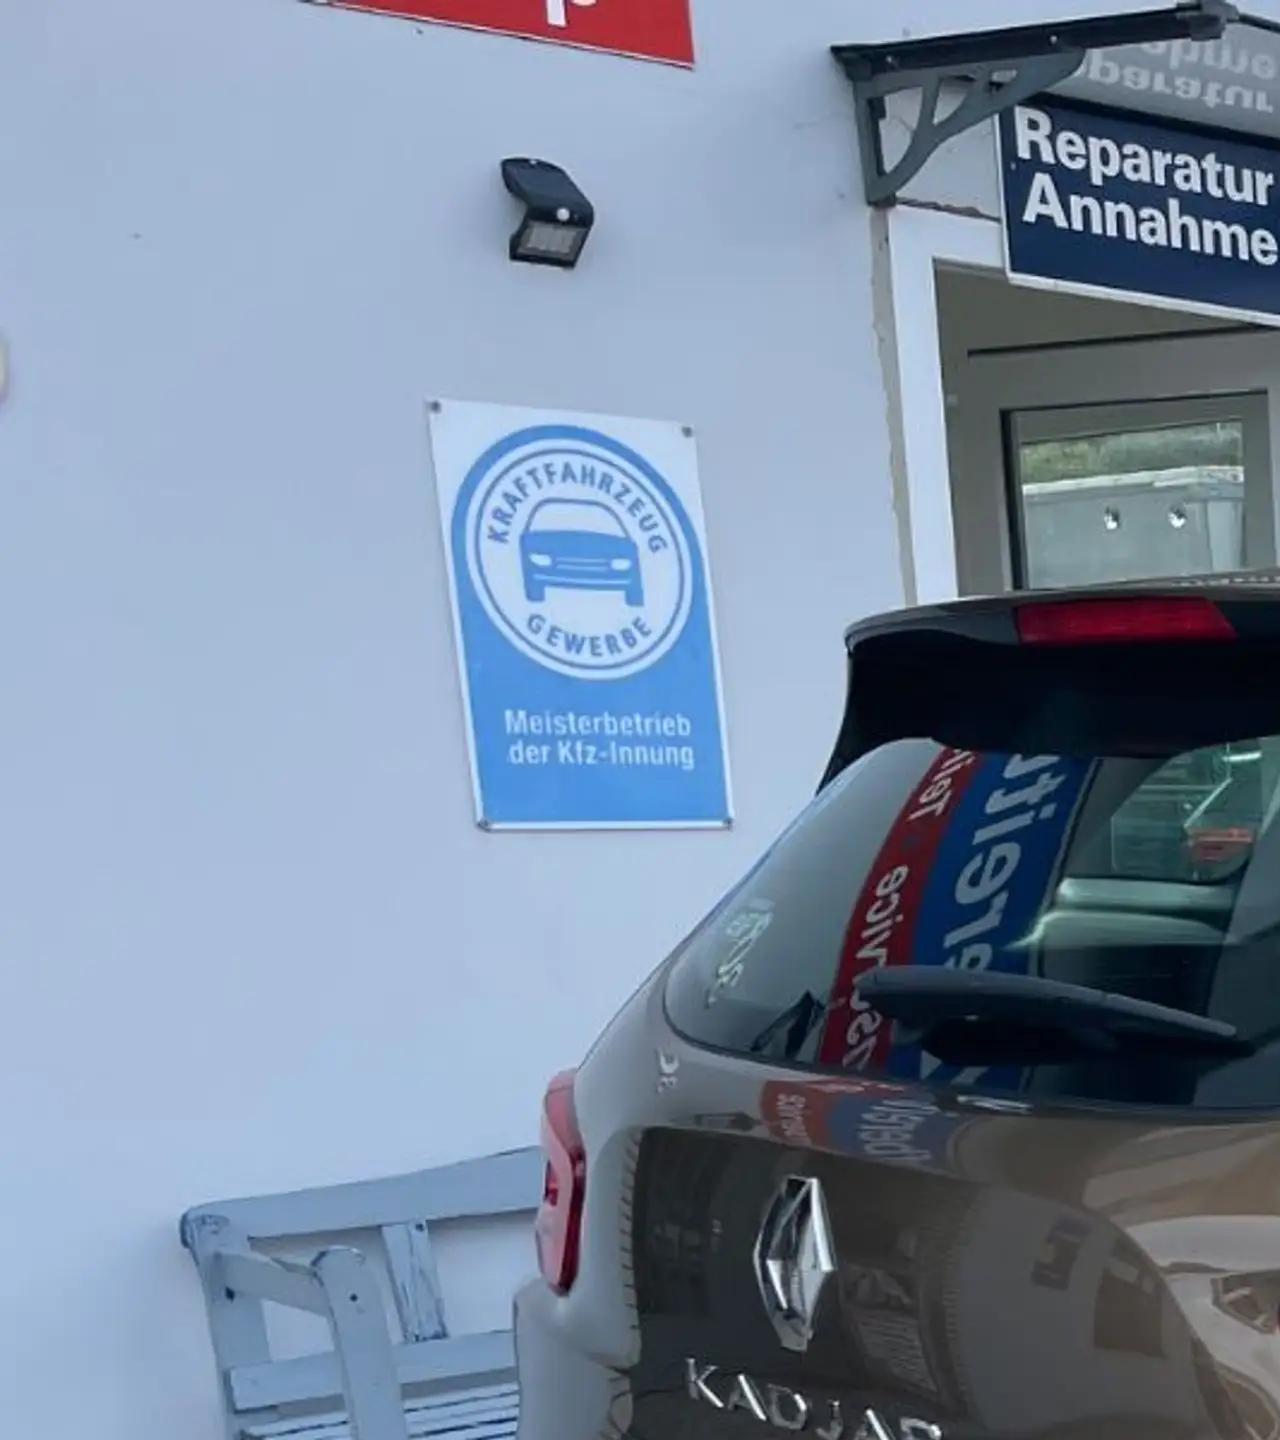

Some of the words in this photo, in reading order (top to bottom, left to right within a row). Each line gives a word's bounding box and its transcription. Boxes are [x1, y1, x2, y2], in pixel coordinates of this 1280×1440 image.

[1014, 105, 1275, 205] Reparatur
[1022, 173, 1278, 266] Annahme
[487, 462, 668, 555] KRAFTFAHRZEUG
[526, 612, 652, 658] GEWERBE
[504, 709, 692, 737] Meisterbetrieb
[509, 739, 551, 765] der
[558, 740, 695, 771] Kfz-Innung
